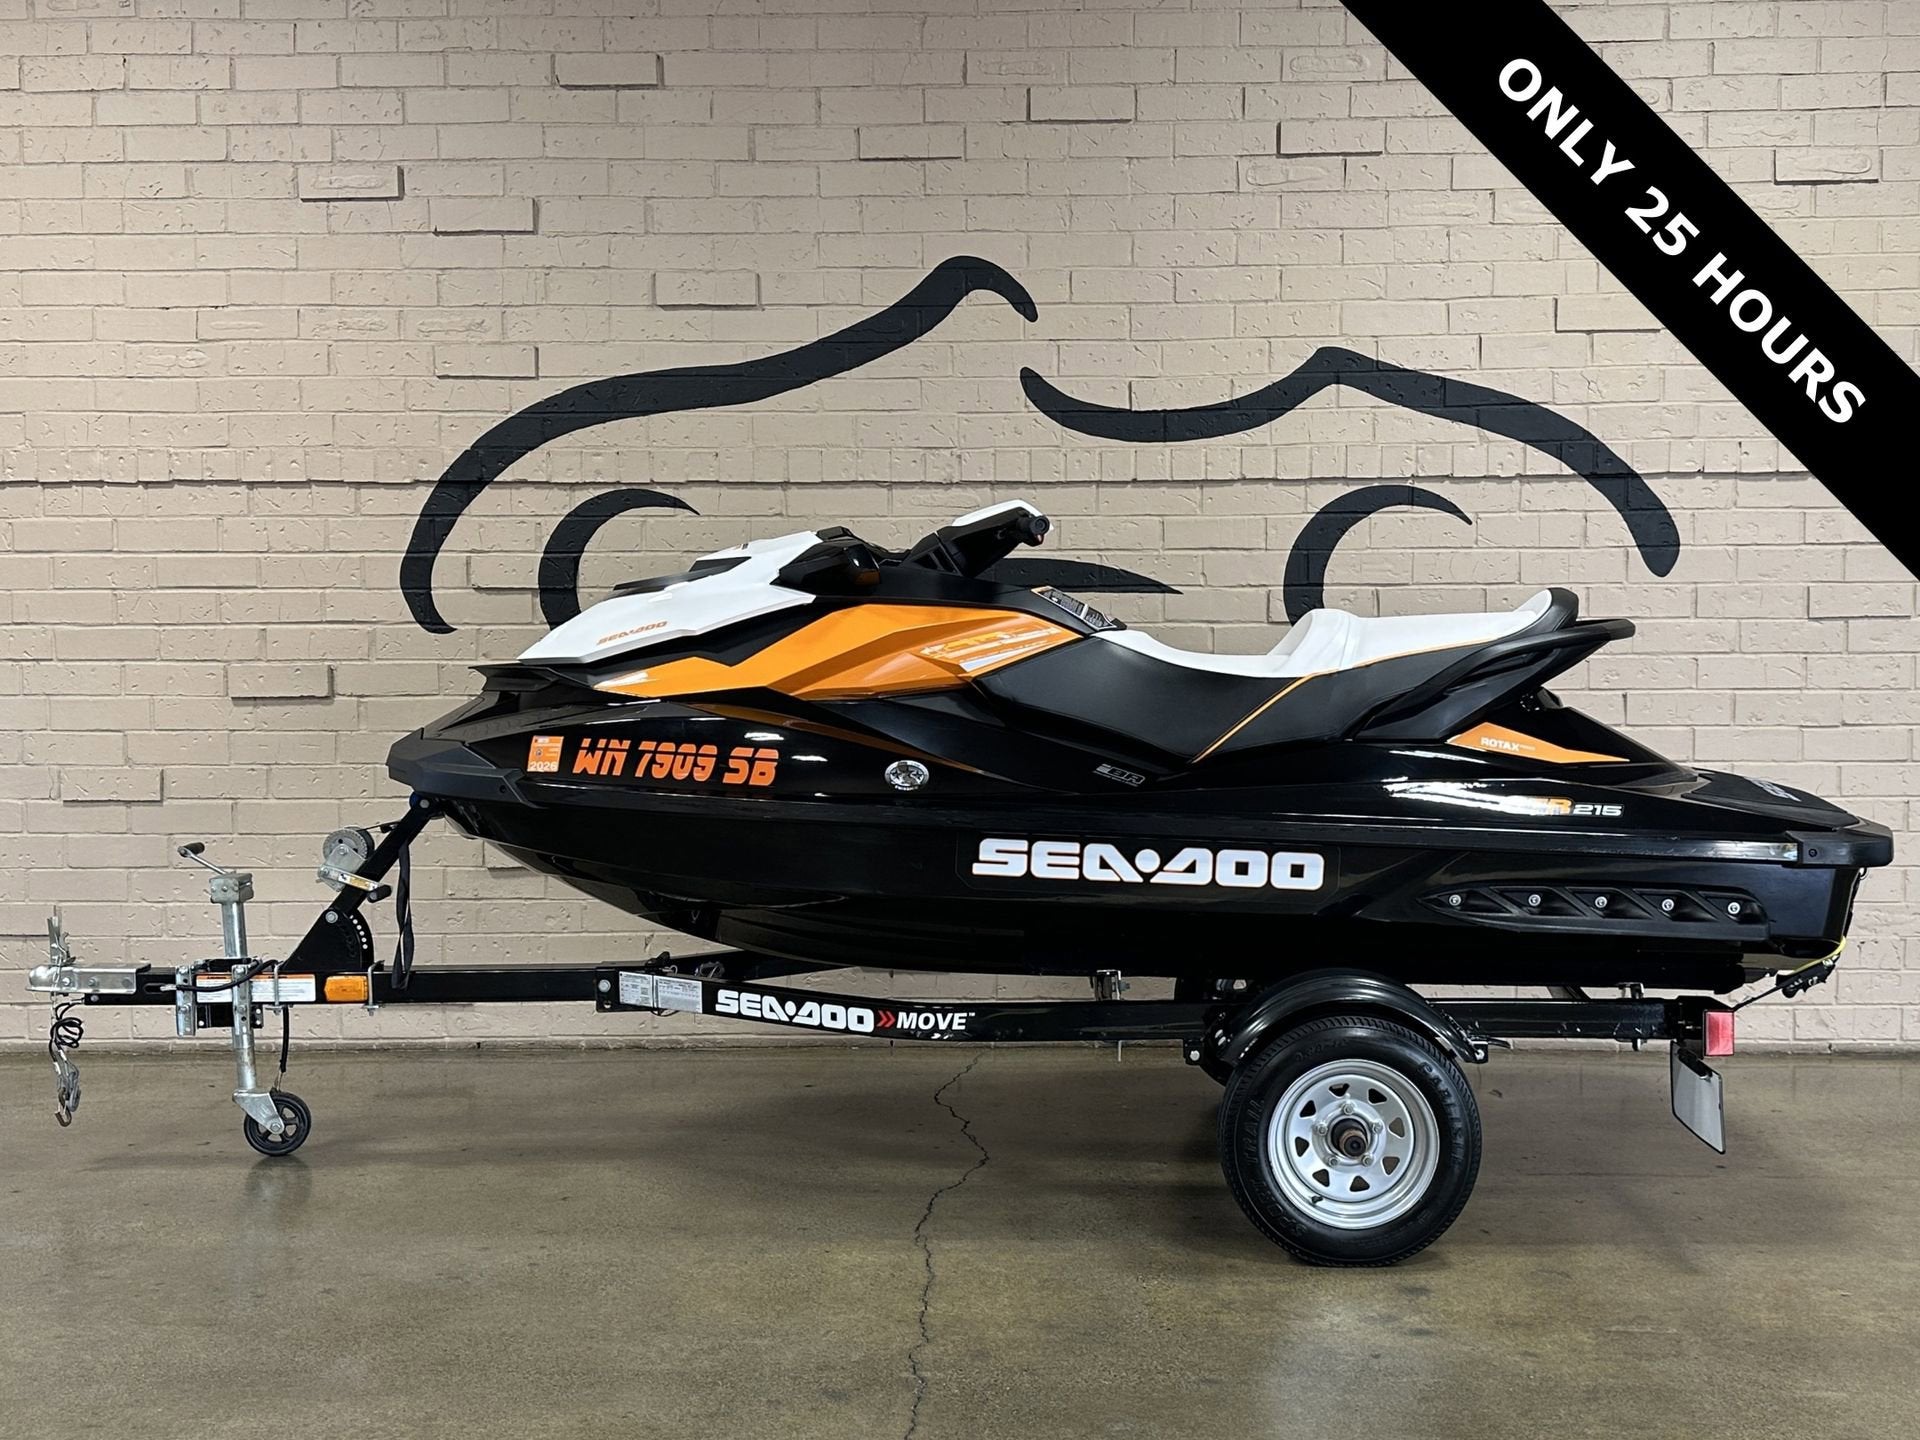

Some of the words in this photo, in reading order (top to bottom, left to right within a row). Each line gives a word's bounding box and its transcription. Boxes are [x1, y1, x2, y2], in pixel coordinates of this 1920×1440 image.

[1480, 736, 1520, 752] ROTAX
[529, 760, 558, 771] 2026
[572, 738, 632, 777] WN
[634, 740, 718, 782] 7909
[722, 746, 779, 786] SB
[1571, 802, 1624, 817] 215
